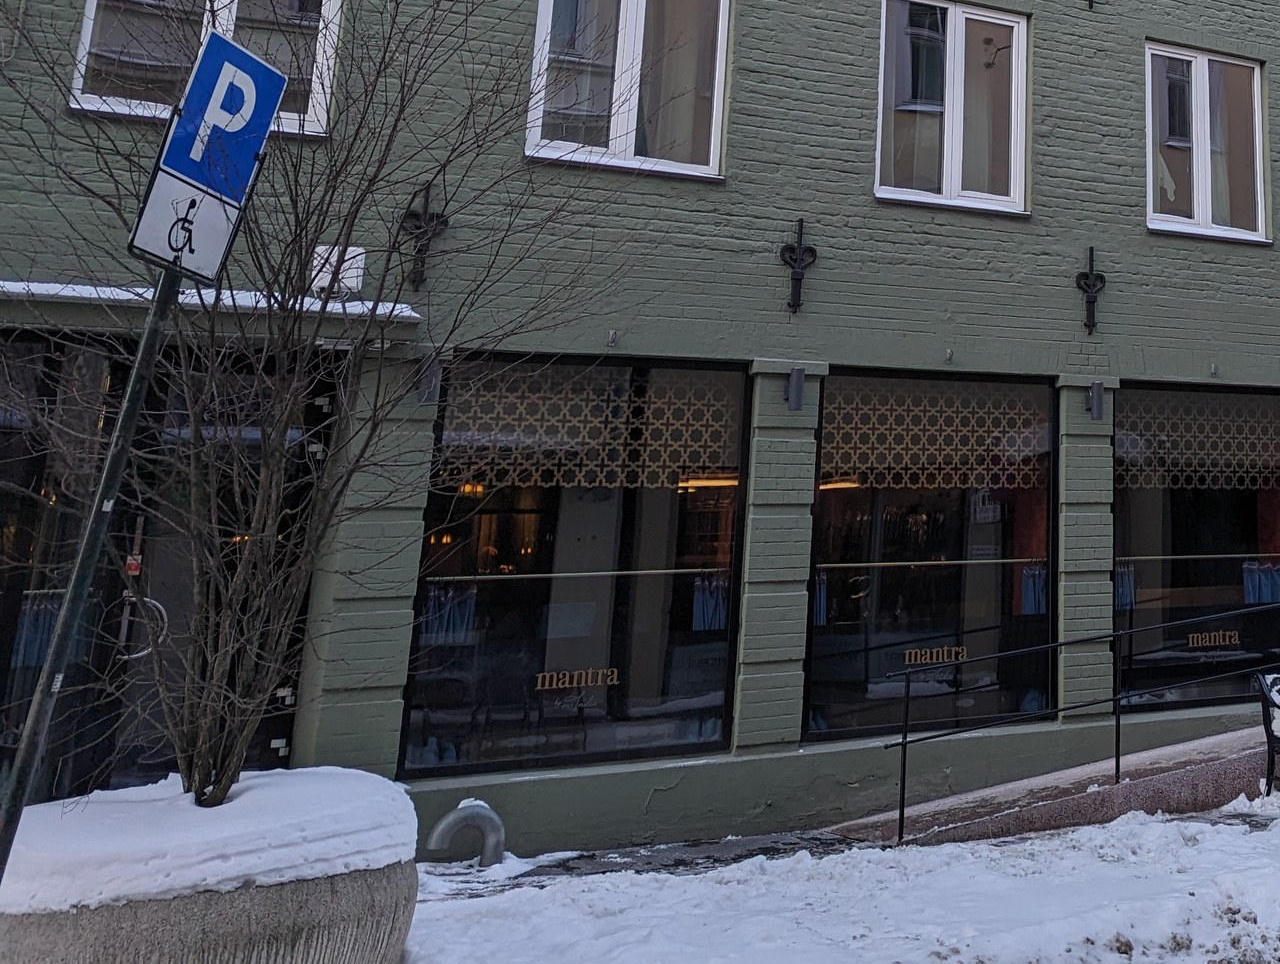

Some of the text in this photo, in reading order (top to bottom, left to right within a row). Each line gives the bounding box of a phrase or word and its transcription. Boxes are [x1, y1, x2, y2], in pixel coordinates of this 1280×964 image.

[189, 60, 257, 163] P
[1187, 629, 1240, 648] mantra
[904, 644, 968, 665] mantra
[534, 667, 620, 691] mantra
